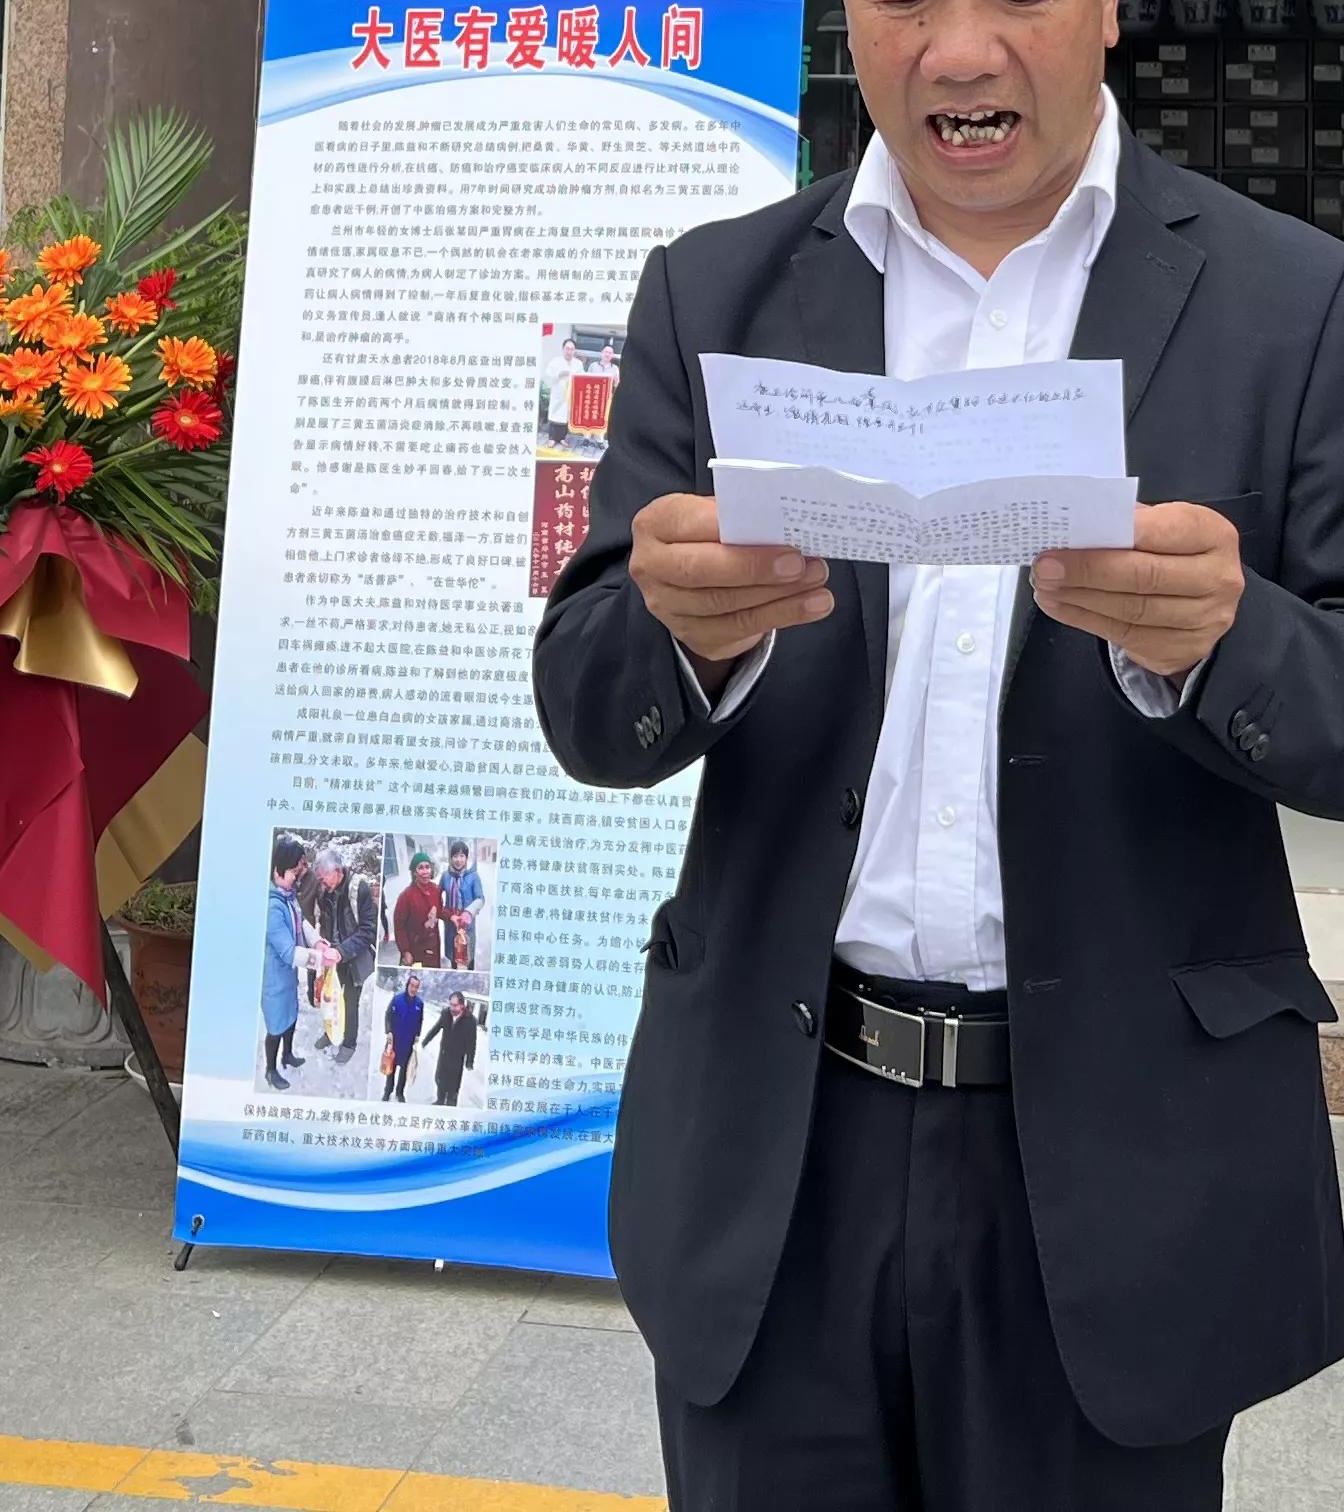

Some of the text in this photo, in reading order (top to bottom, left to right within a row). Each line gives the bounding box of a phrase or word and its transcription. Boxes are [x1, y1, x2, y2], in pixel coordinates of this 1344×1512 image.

[351, 5, 704, 72] 大医有爱暖人间
[491, 1024, 633, 1047] 中医药学是中华民族的伟
[488, 1073, 623, 1095] 保持旺盛的生命力,实现
